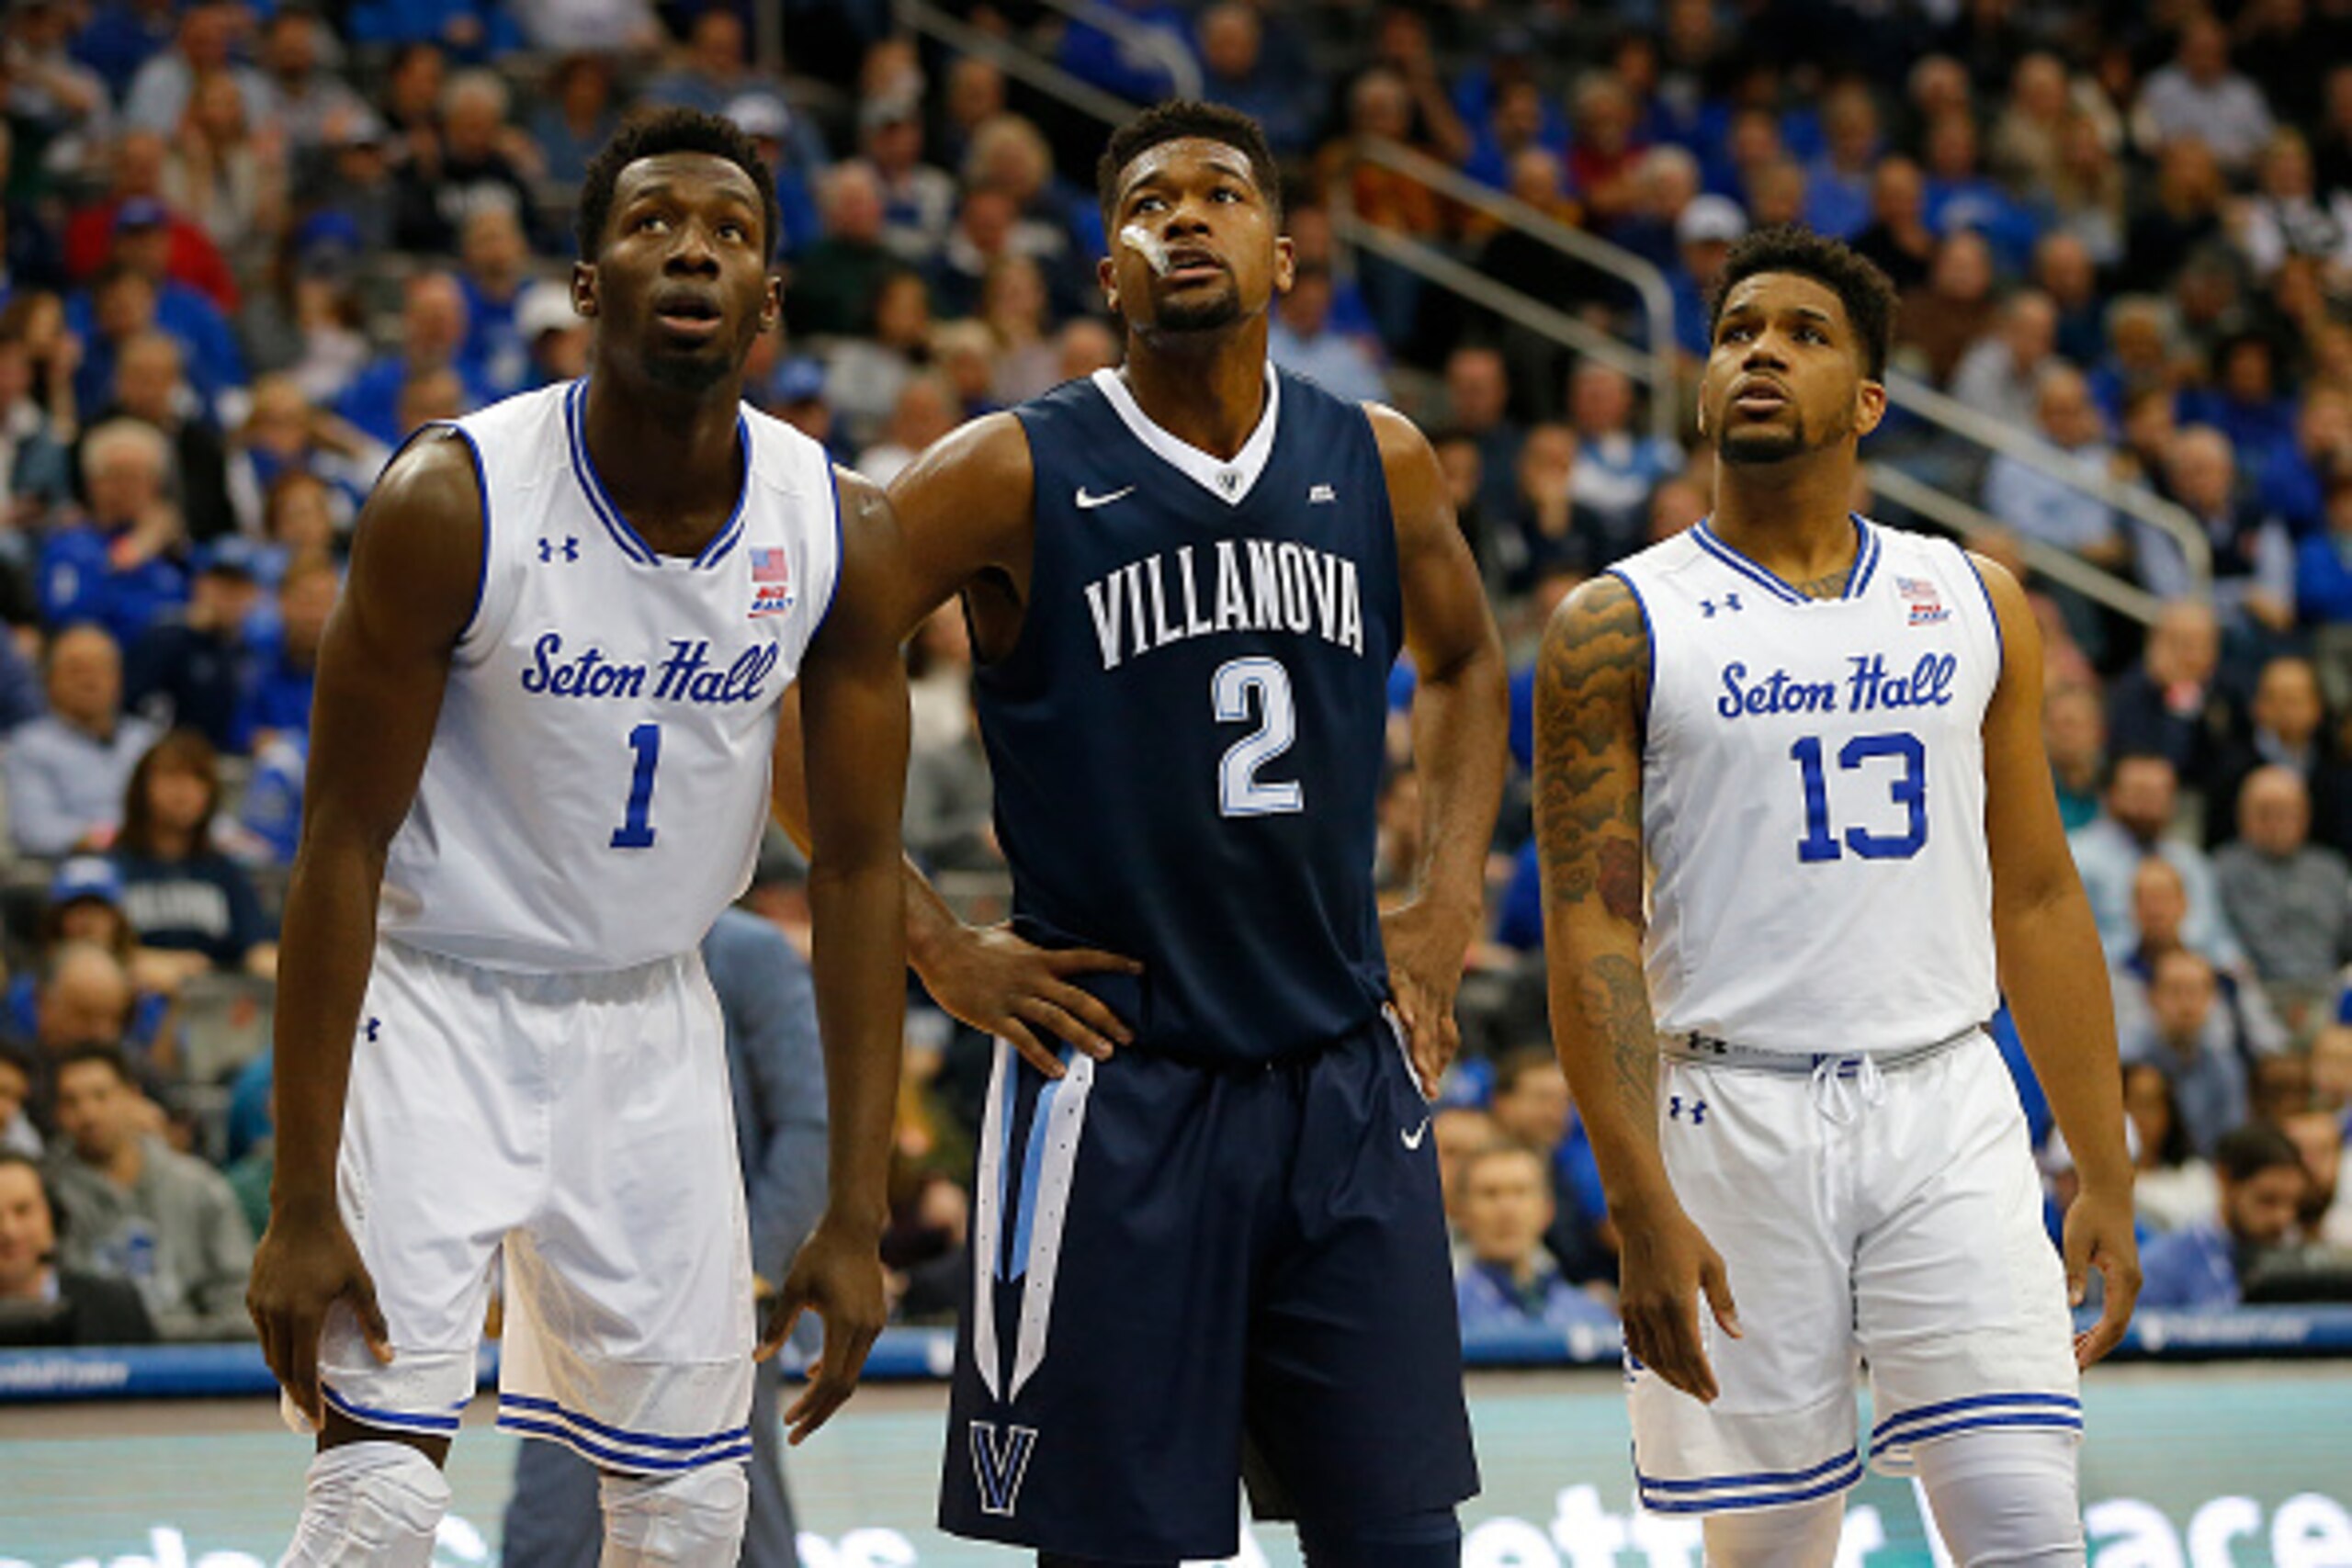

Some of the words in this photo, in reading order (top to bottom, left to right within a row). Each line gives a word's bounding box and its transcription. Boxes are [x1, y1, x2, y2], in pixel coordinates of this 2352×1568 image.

[1084, 539, 1363, 670] VILLANOVA
[522, 633, 647, 698] Seton
[653, 641, 779, 704] Hall
[1717, 661, 1837, 718] Seton
[1846, 653, 1957, 714] Hall
[609, 724, 662, 849] 1
[1212, 656, 1304, 818] 2
[1791, 732, 1928, 863] 13
[969, 1420, 1038, 1517] V
